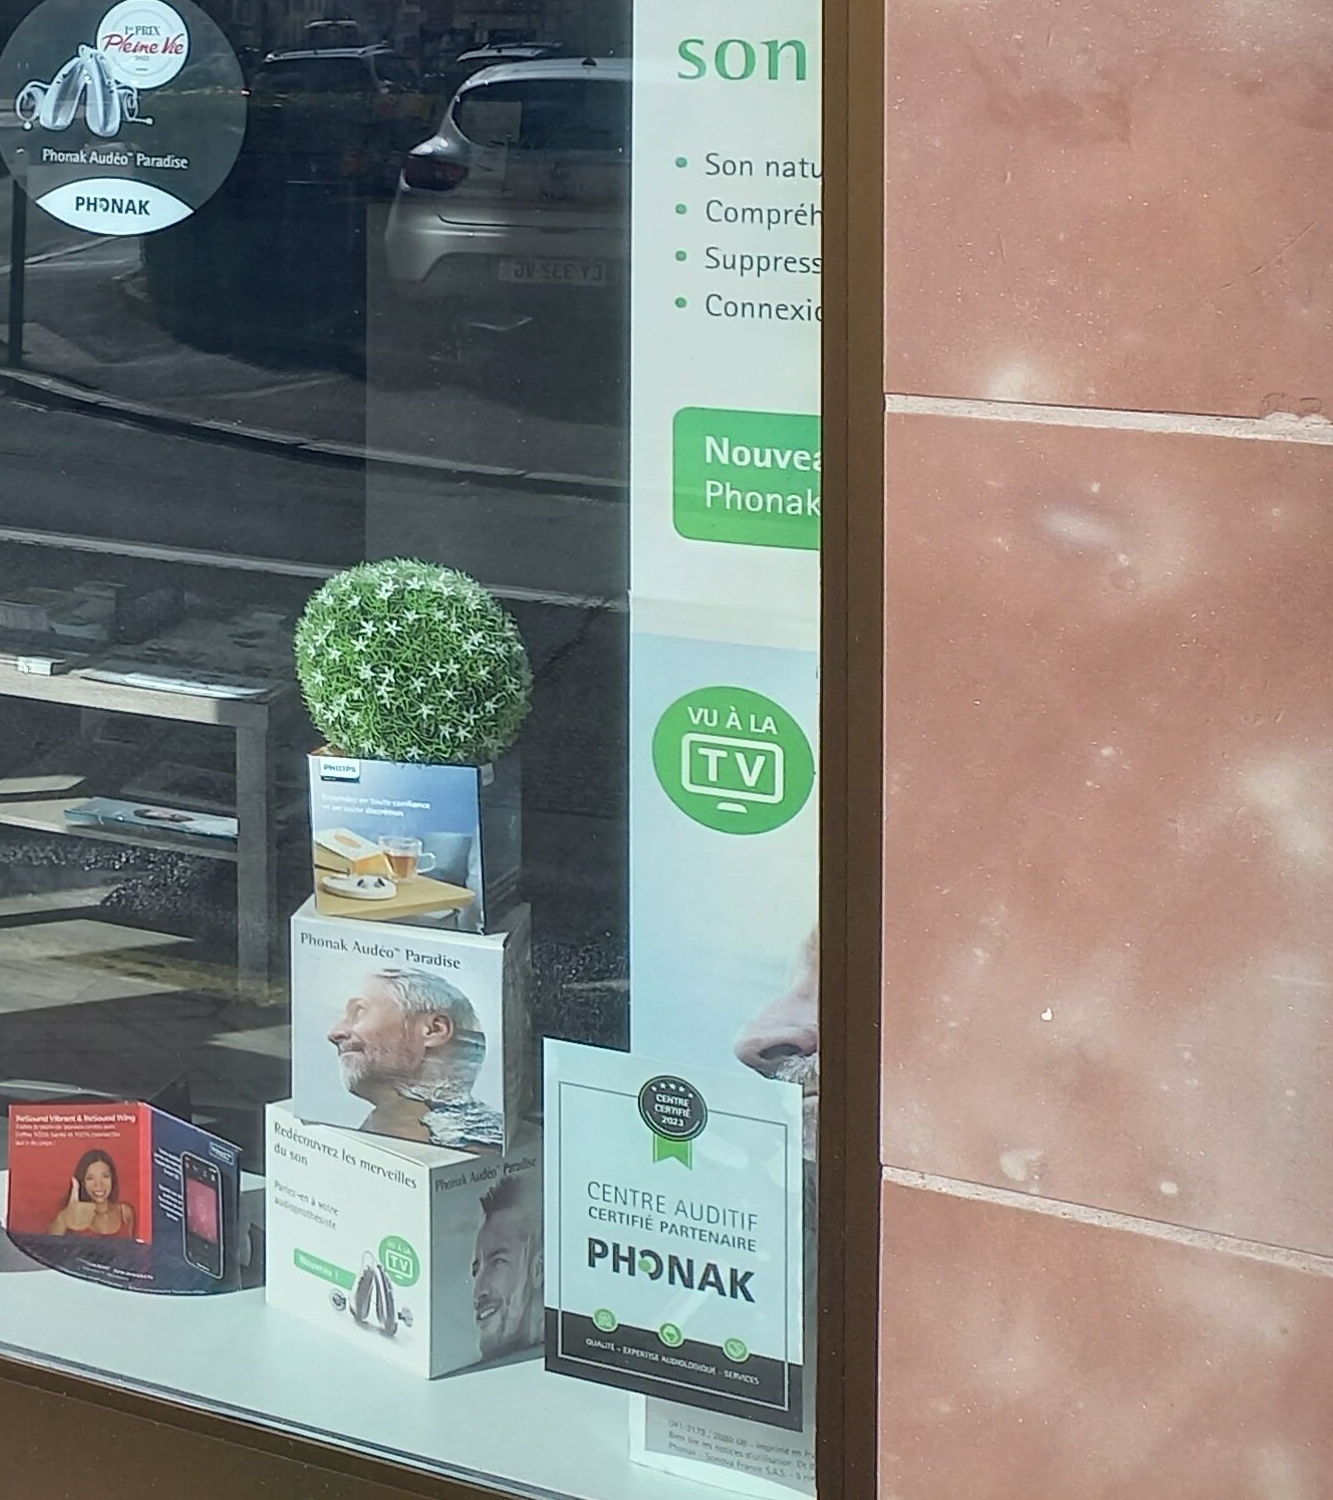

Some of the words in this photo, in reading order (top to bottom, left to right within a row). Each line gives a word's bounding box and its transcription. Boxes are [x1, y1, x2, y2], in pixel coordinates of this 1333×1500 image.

[101, 33, 159, 55] Pleine
[162, 34, 185, 55] Vie
[134, 26, 161, 36] PRIX
[676, 34, 808, 83] son
[42, 148, 87, 164] Phonak
[136, 154, 189, 169] Paradise
[704, 152, 753, 178] Son
[75, 195, 150, 215] PHONAK
[686, 706, 719, 727] VU
[726, 705, 742, 731] À
[750, 713, 778, 735] LA
[698, 746, 767, 788] TV
[300, 931, 348, 952] Phonak
[405, 948, 461, 970] Paradise
[653, 1102, 692, 1119] CERTIFIÉ
[654, 1092, 690, 1108] CENTRE
[274, 1141, 287, 1157] du
[290, 1151, 309, 1167] son
[274, 1121, 339, 1157] Redécouvrez
[342, 1147, 357, 1166] les
[360, 1160, 417, 1190] merveilles
[435, 1174, 468, 1194] Phonak
[587, 1181, 666, 1215] CENTRE
[674, 1197, 758, 1232] AUDITIF
[588, 1205, 653, 1232] CERTIFIÉ
[659, 1219, 757, 1252] PARTENAIRE
[389, 1256, 410, 1272] TV
[587, 1236, 756, 1304] PHONAK
